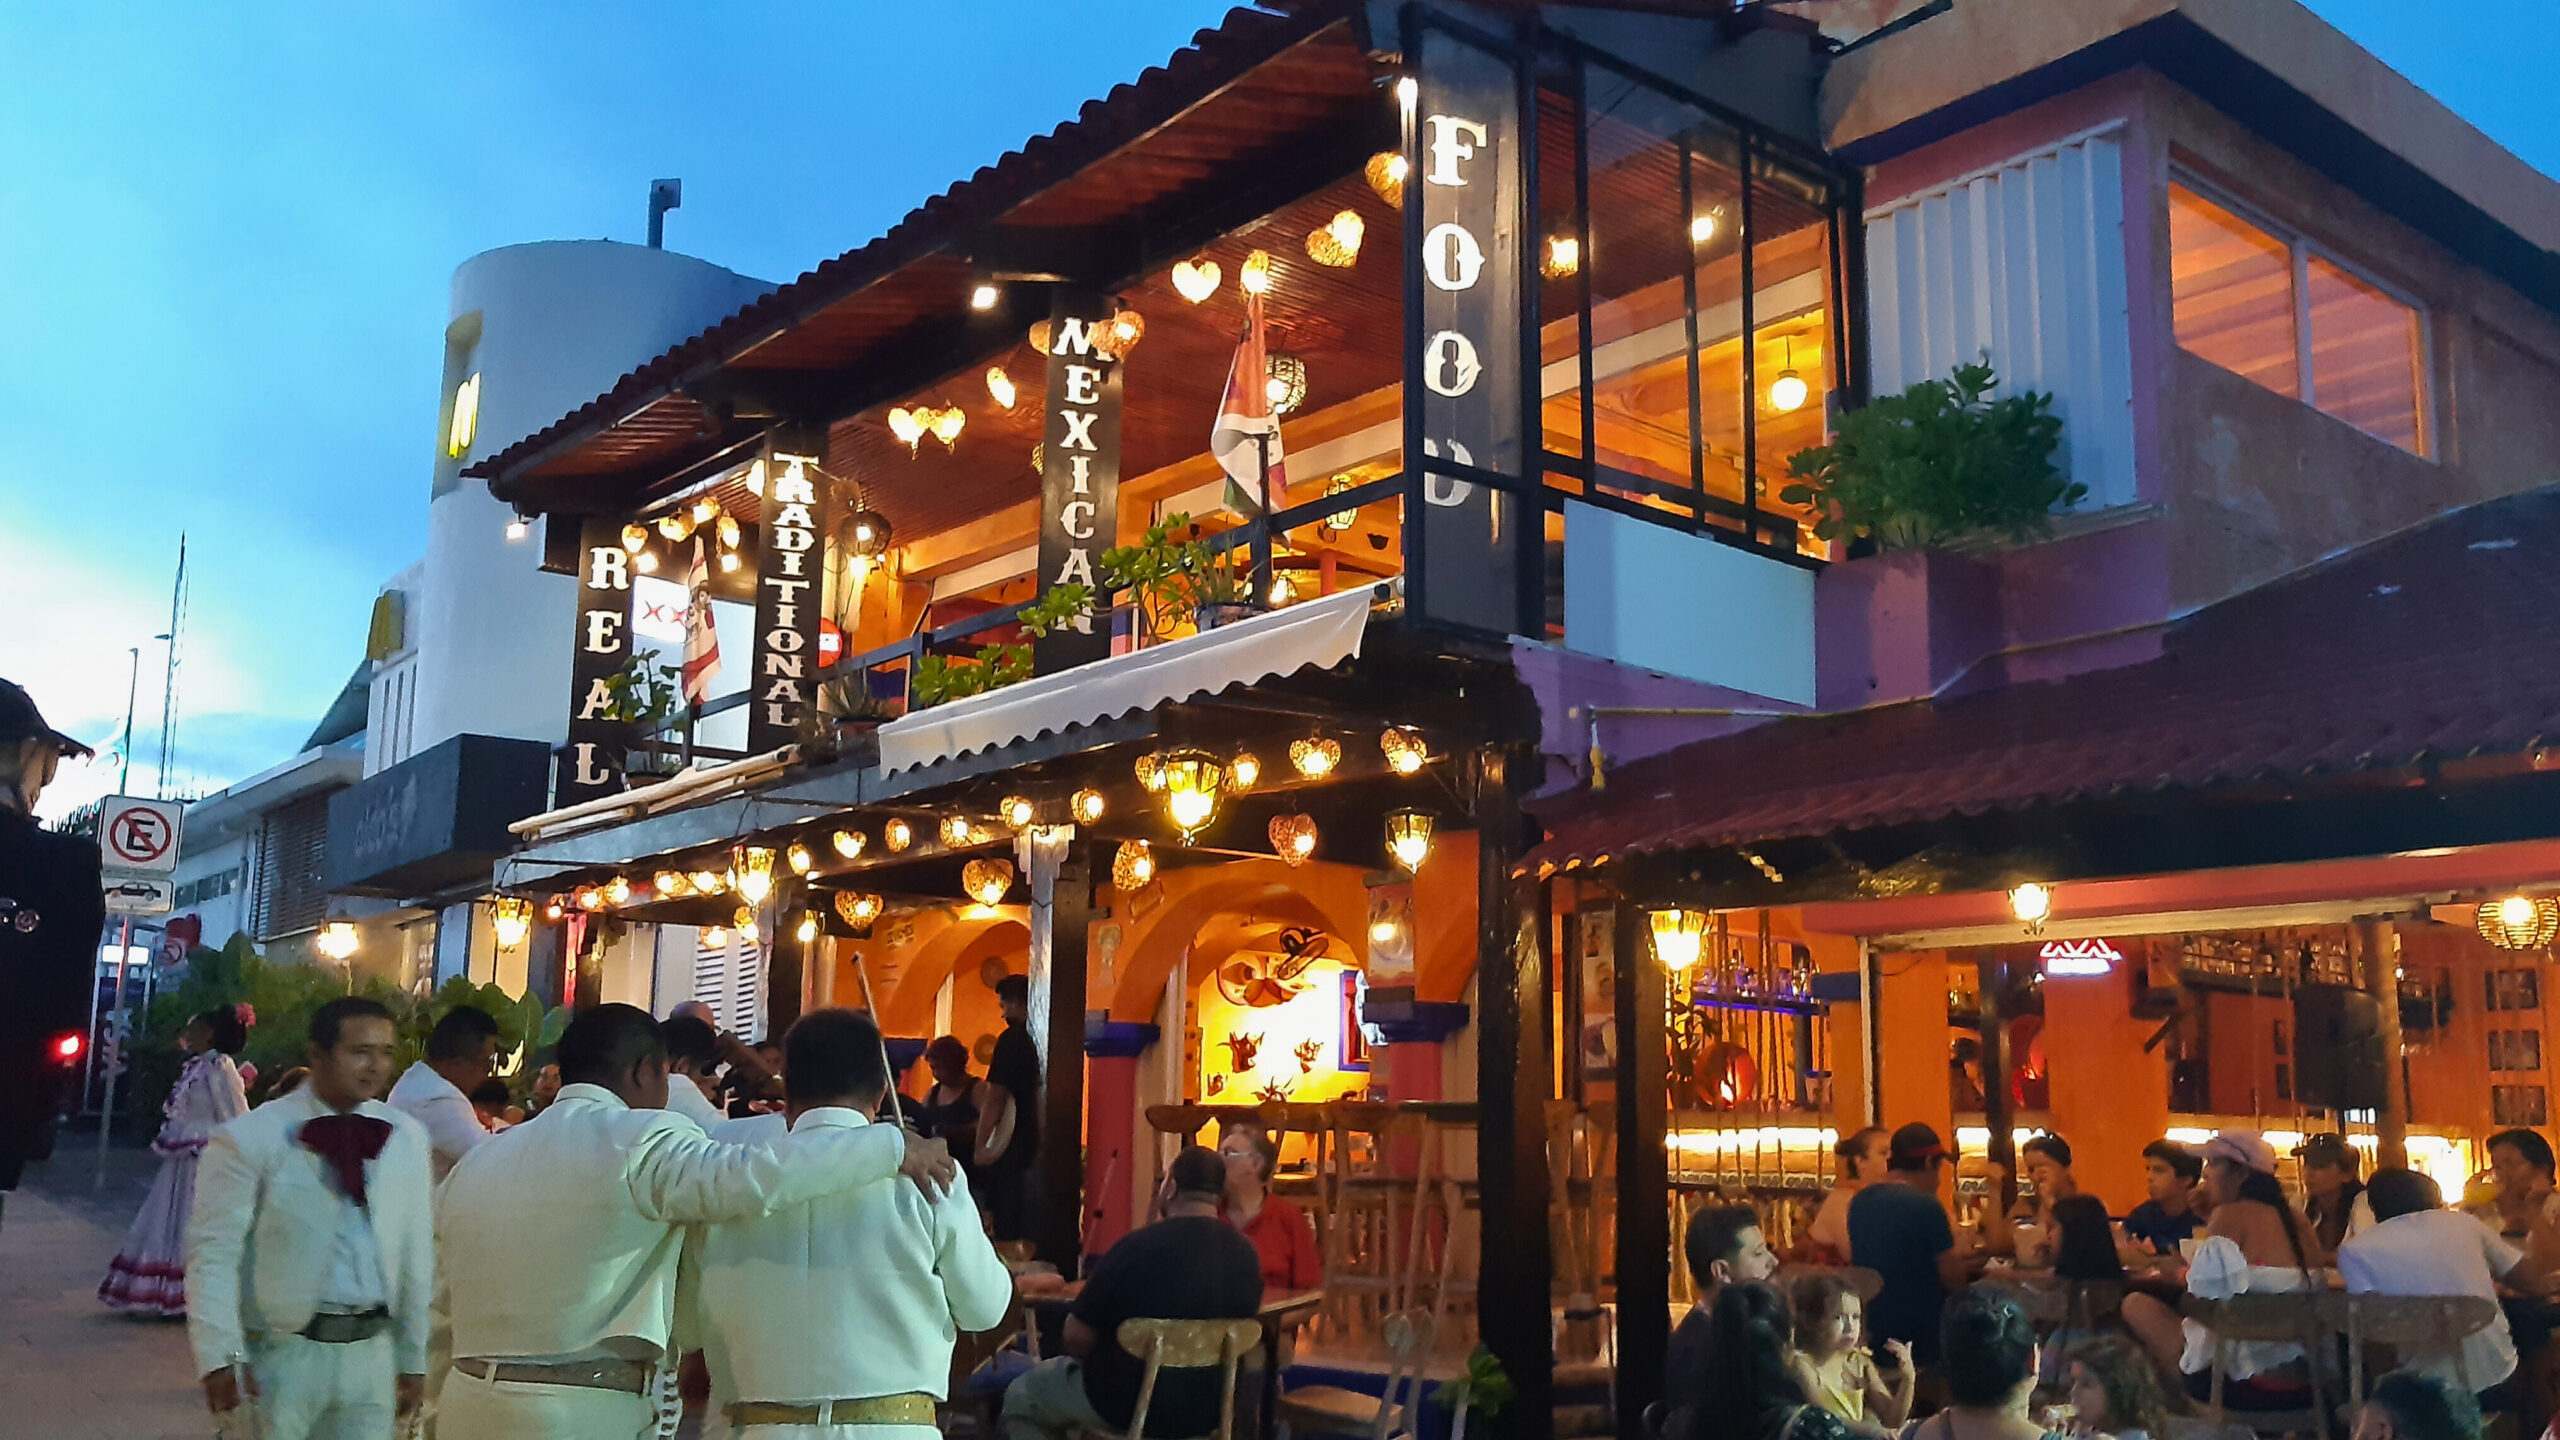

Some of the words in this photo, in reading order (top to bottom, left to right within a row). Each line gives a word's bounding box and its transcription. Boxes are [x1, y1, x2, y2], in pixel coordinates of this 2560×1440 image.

[1423, 113, 1488, 507] FOOD
[573, 546, 630, 786] REAL
[763, 452, 820, 727] TRADITIONAL
[126, 818, 156, 851] E
